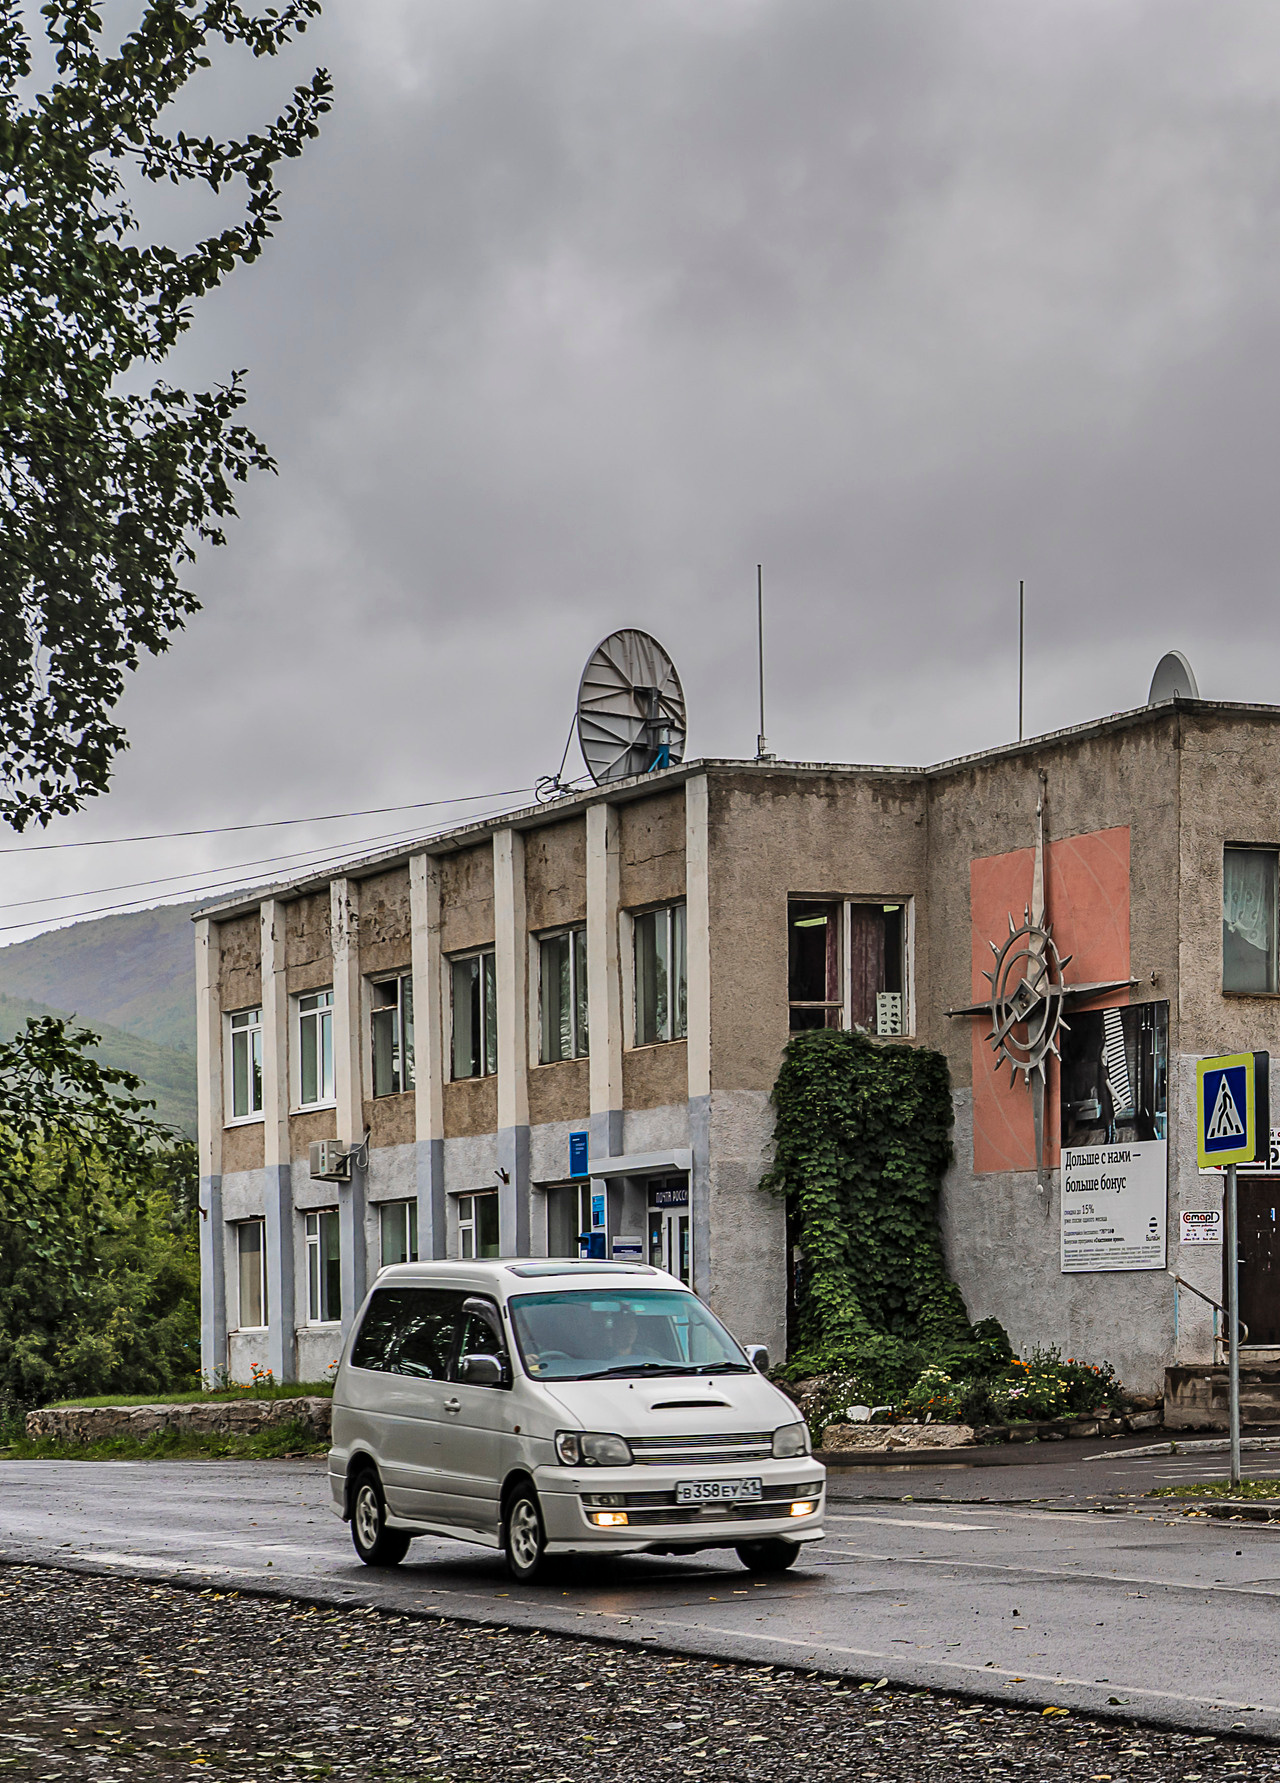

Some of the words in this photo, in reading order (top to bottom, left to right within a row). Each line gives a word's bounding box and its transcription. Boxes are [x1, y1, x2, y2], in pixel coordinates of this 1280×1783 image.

[1065, 1152, 1100, 1170] Дольше
[1101, 1154, 1106, 1165] с
[1108, 1151, 1131, 1163] нами
[1065, 1176, 1099, 1193] больше
[1101, 1173, 1127, 1193] бонус
[1082, 1204, 1095, 1214] 15%
